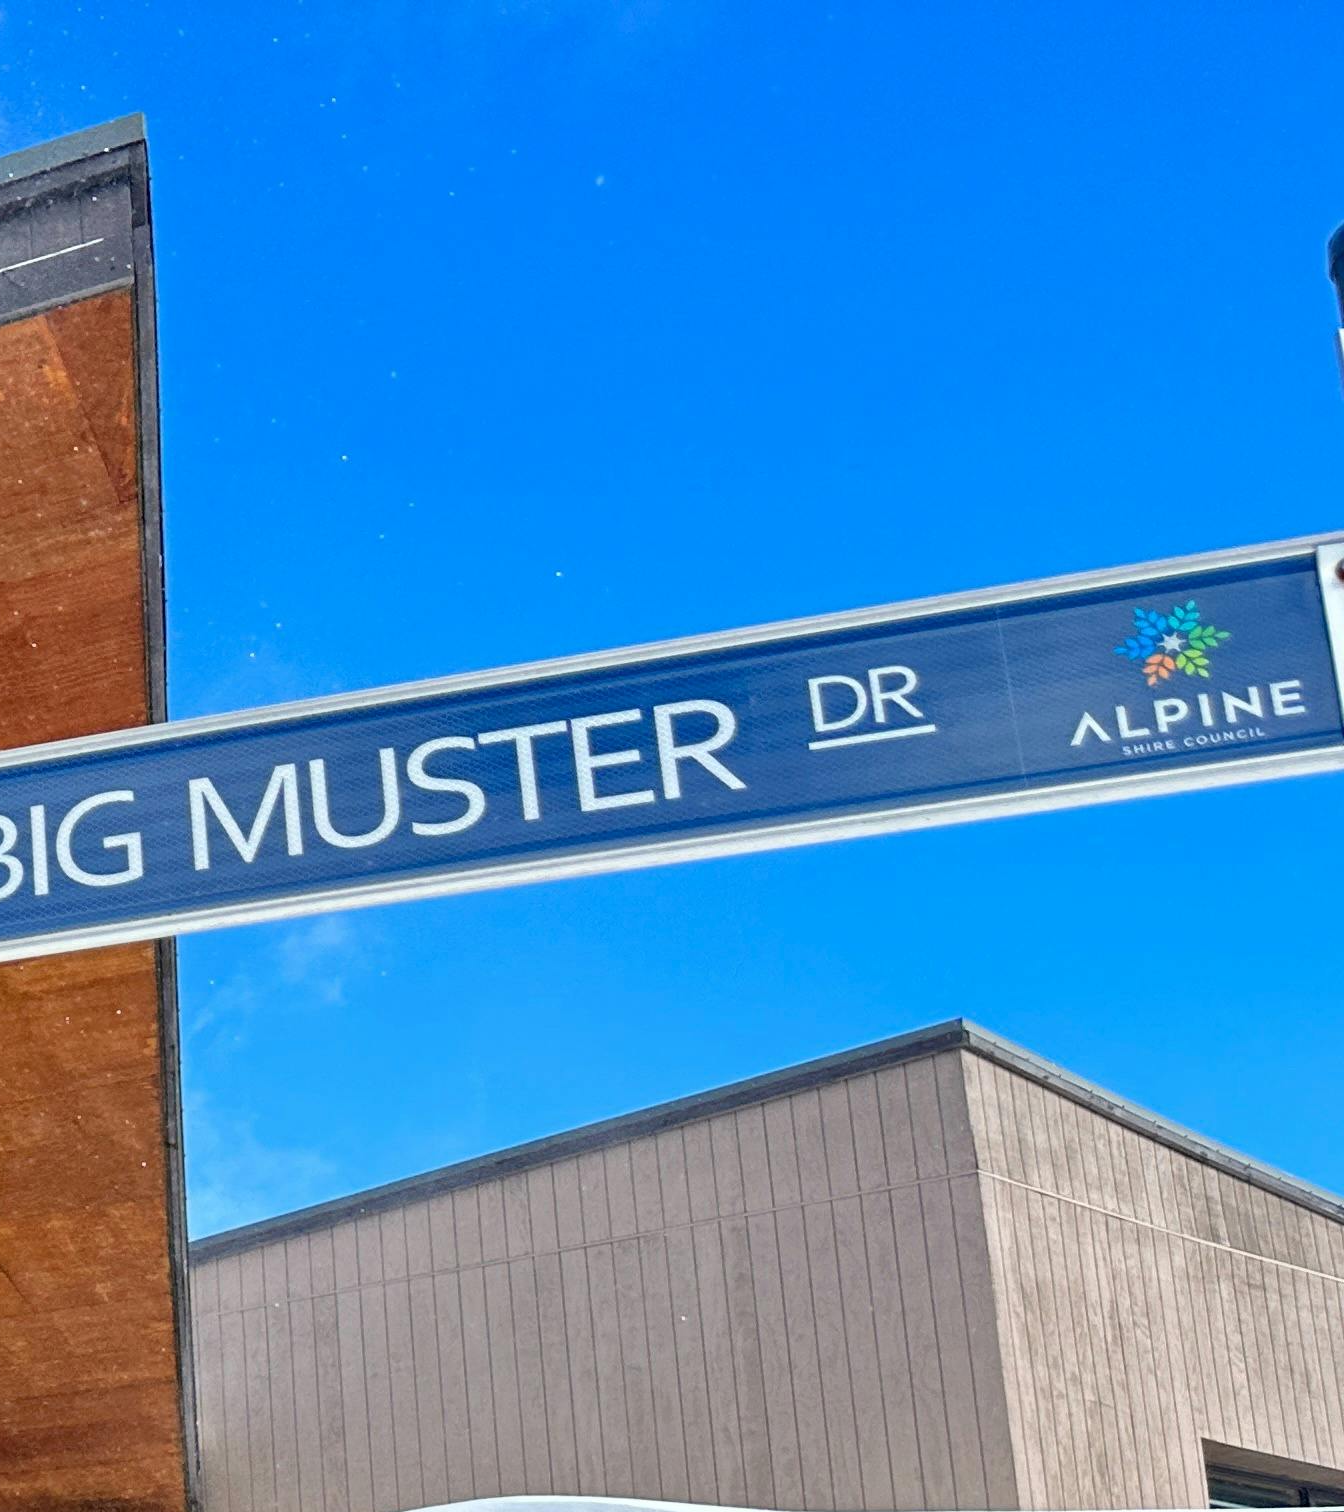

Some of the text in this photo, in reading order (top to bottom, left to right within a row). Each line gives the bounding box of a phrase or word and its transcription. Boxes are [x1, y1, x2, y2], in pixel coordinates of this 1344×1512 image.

[1070, 679, 1307, 747] ALPINE
[1122, 727, 1266, 756] SHIRE COUNCIL
[187, 698, 748, 871] MUSTER
[807, 664, 925, 734] DR
